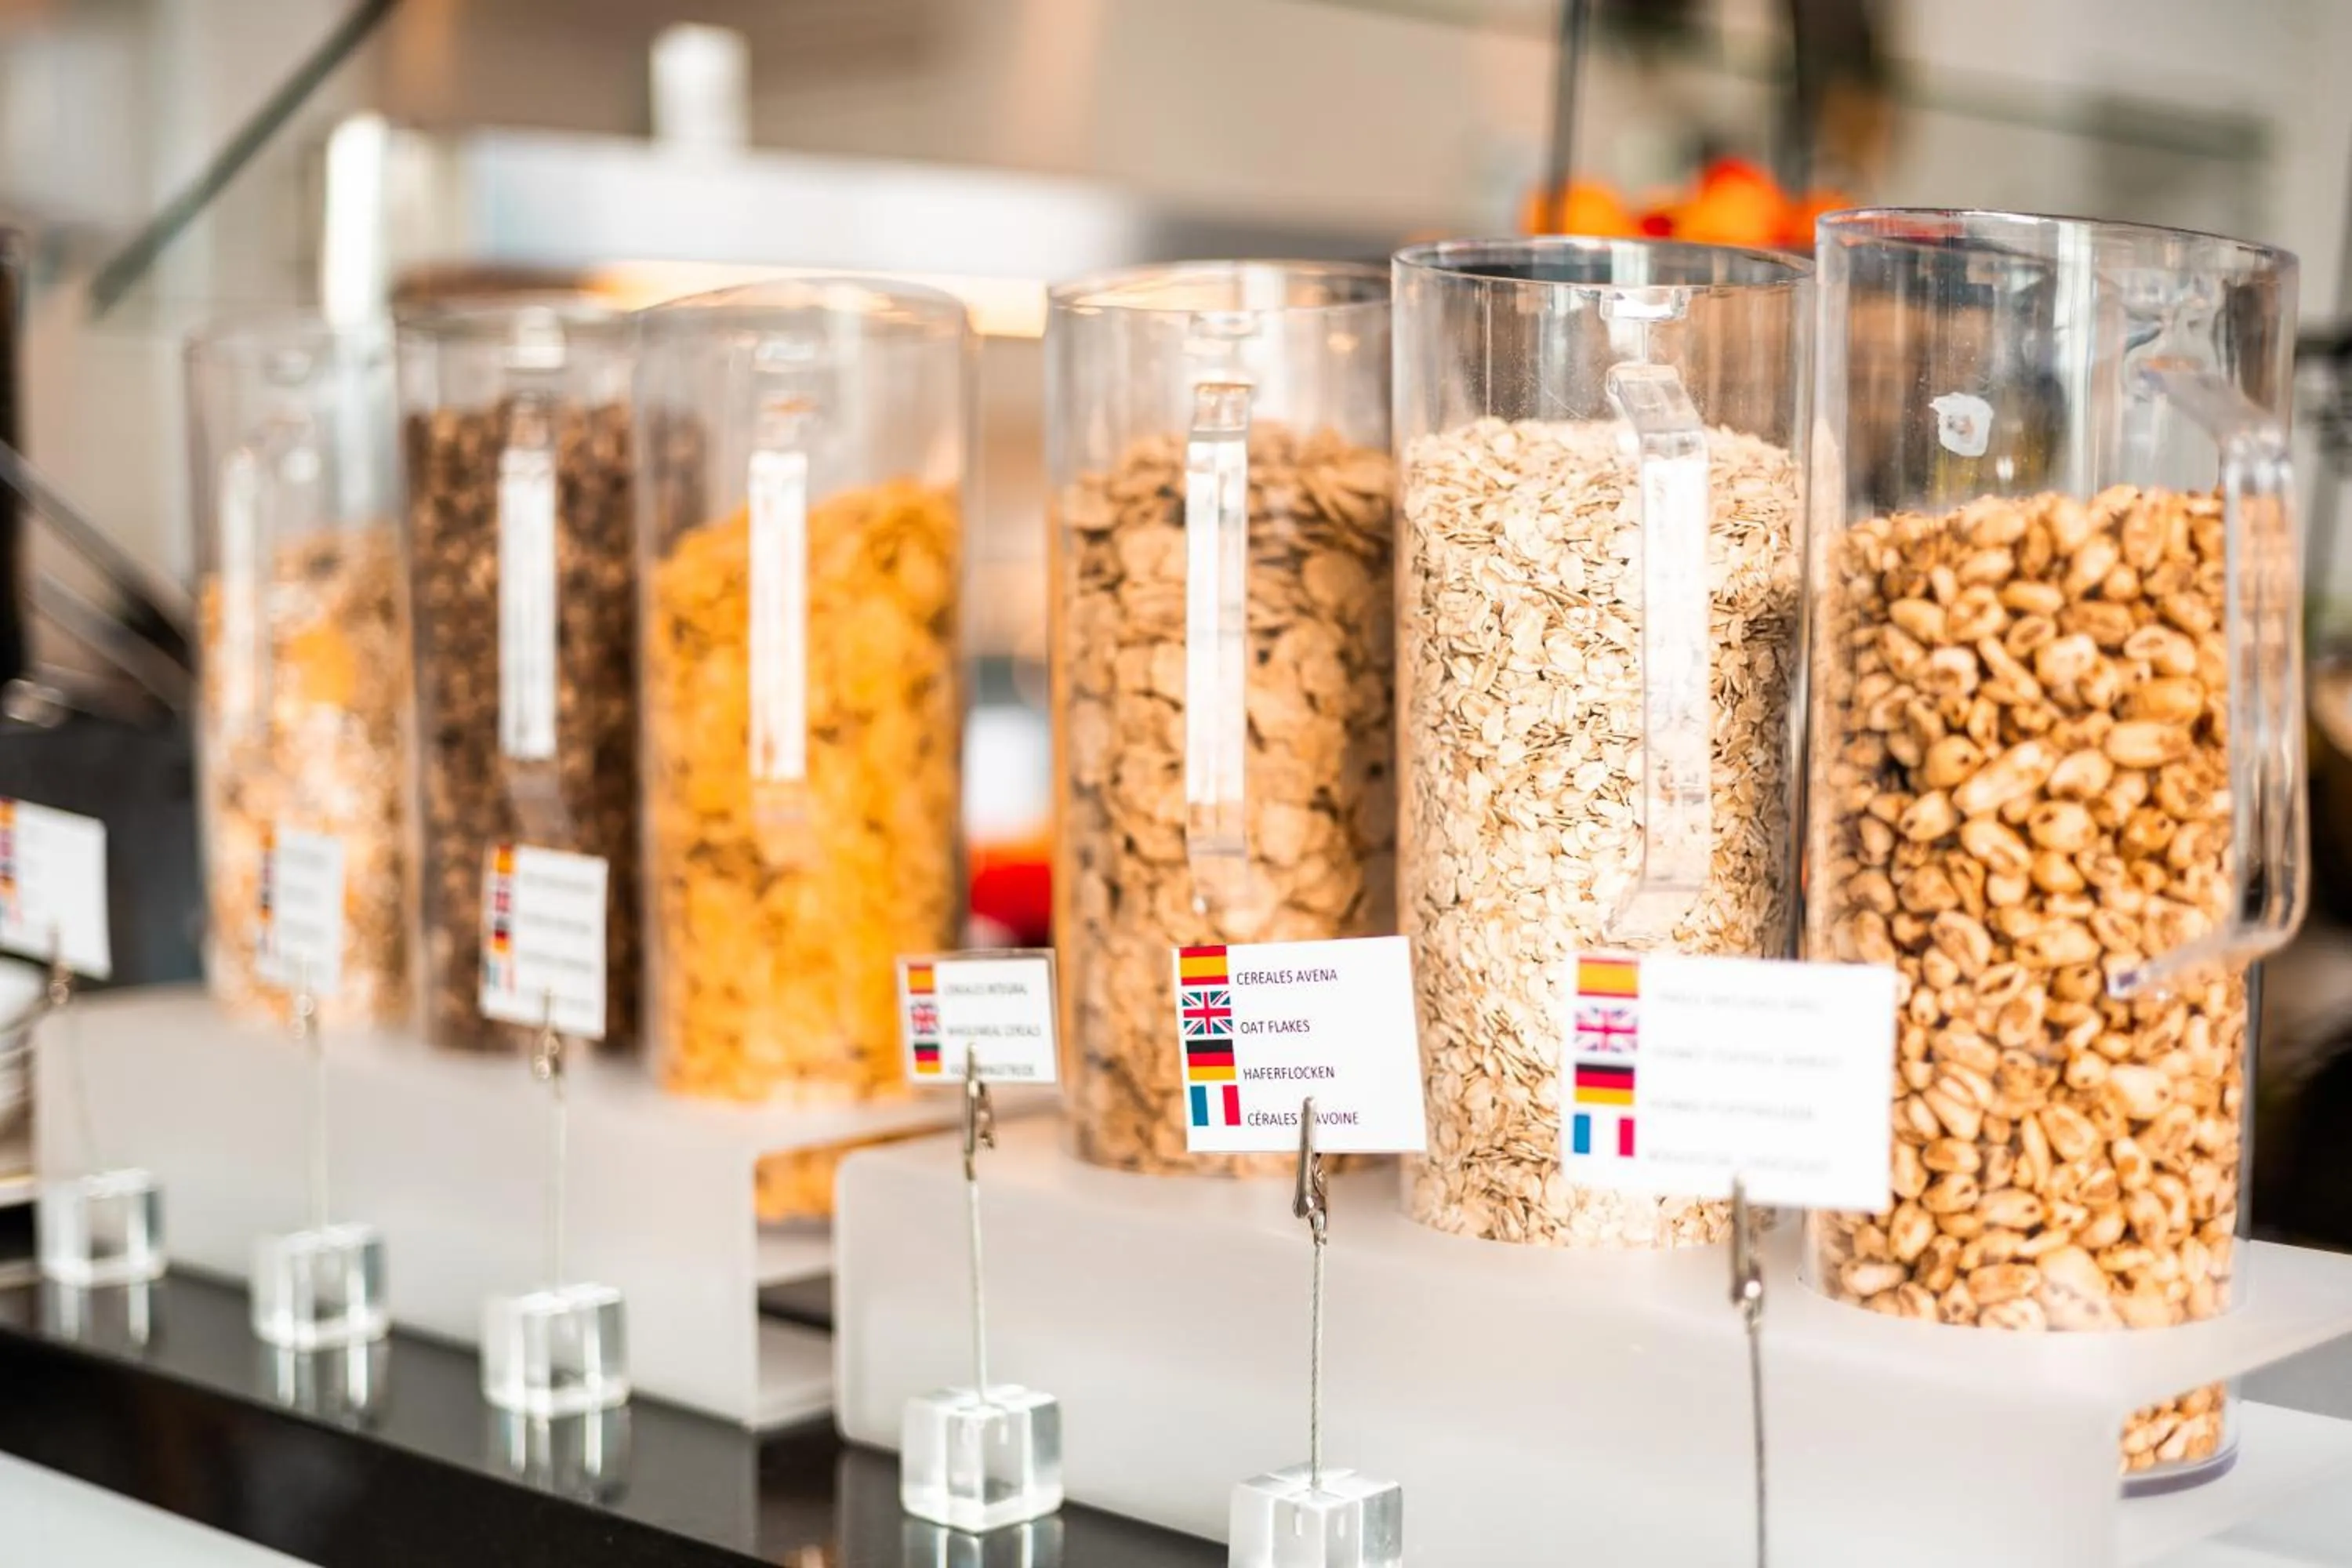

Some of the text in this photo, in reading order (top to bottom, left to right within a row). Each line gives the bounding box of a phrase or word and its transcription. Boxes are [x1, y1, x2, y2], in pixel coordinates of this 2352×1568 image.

[1236, 969, 1338, 985] CEREALES AVENA
[1240, 1020, 1310, 1034] OAT FLAKES
[1243, 1065, 1335, 1080] HAFERFLOCKEN
[1247, 1110, 1298, 1127] CÉRALES
